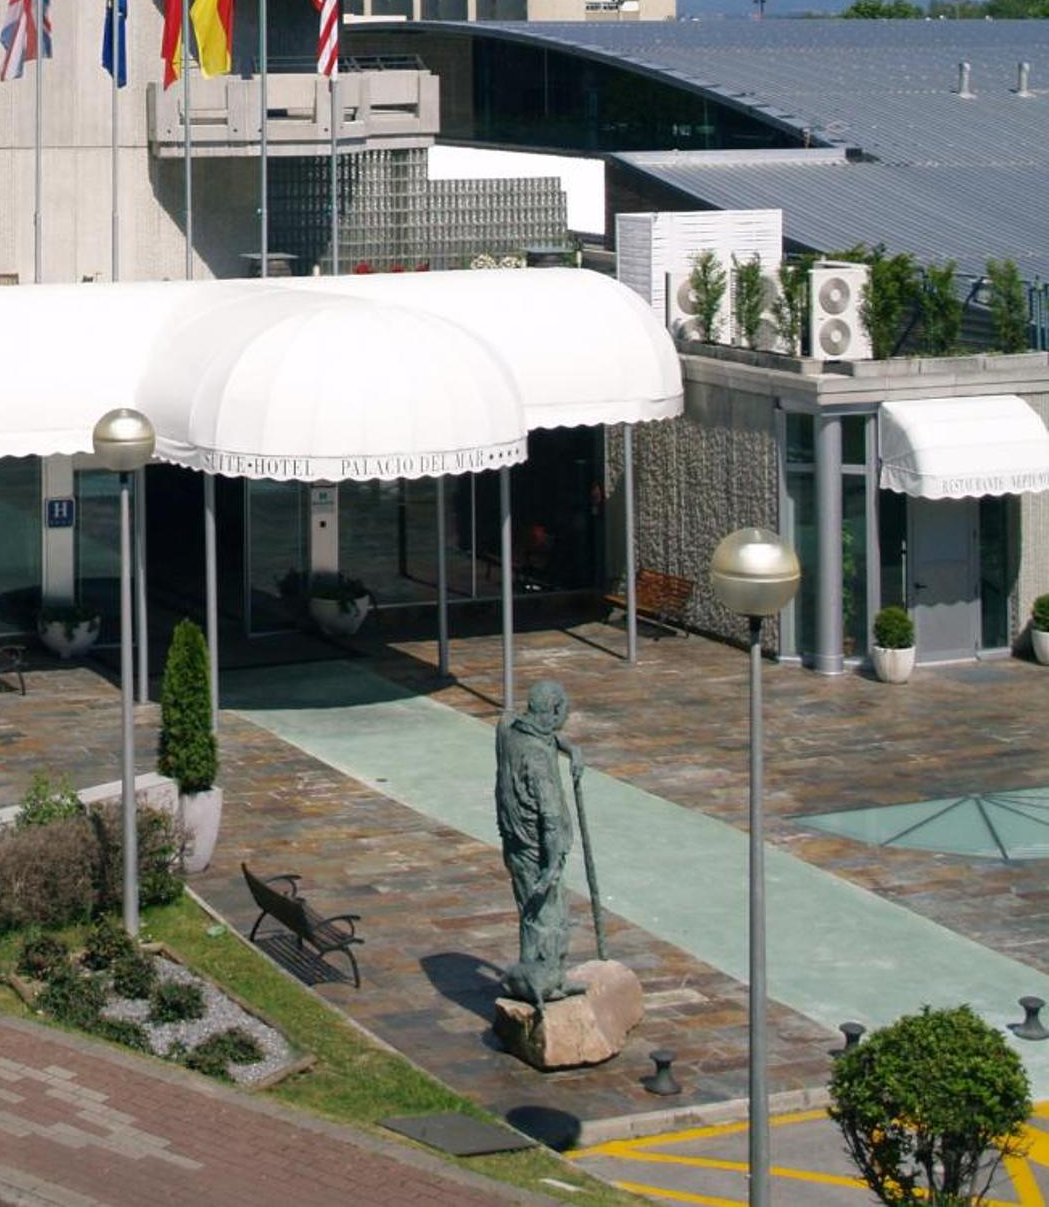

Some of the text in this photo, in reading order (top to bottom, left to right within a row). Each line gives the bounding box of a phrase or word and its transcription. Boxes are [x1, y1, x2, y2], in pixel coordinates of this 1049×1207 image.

[341, 456, 414, 477] PALACIO
[420, 453, 450, 473] DEL
[455, 449, 485, 469] MAR
[54, 502, 67, 518] H
